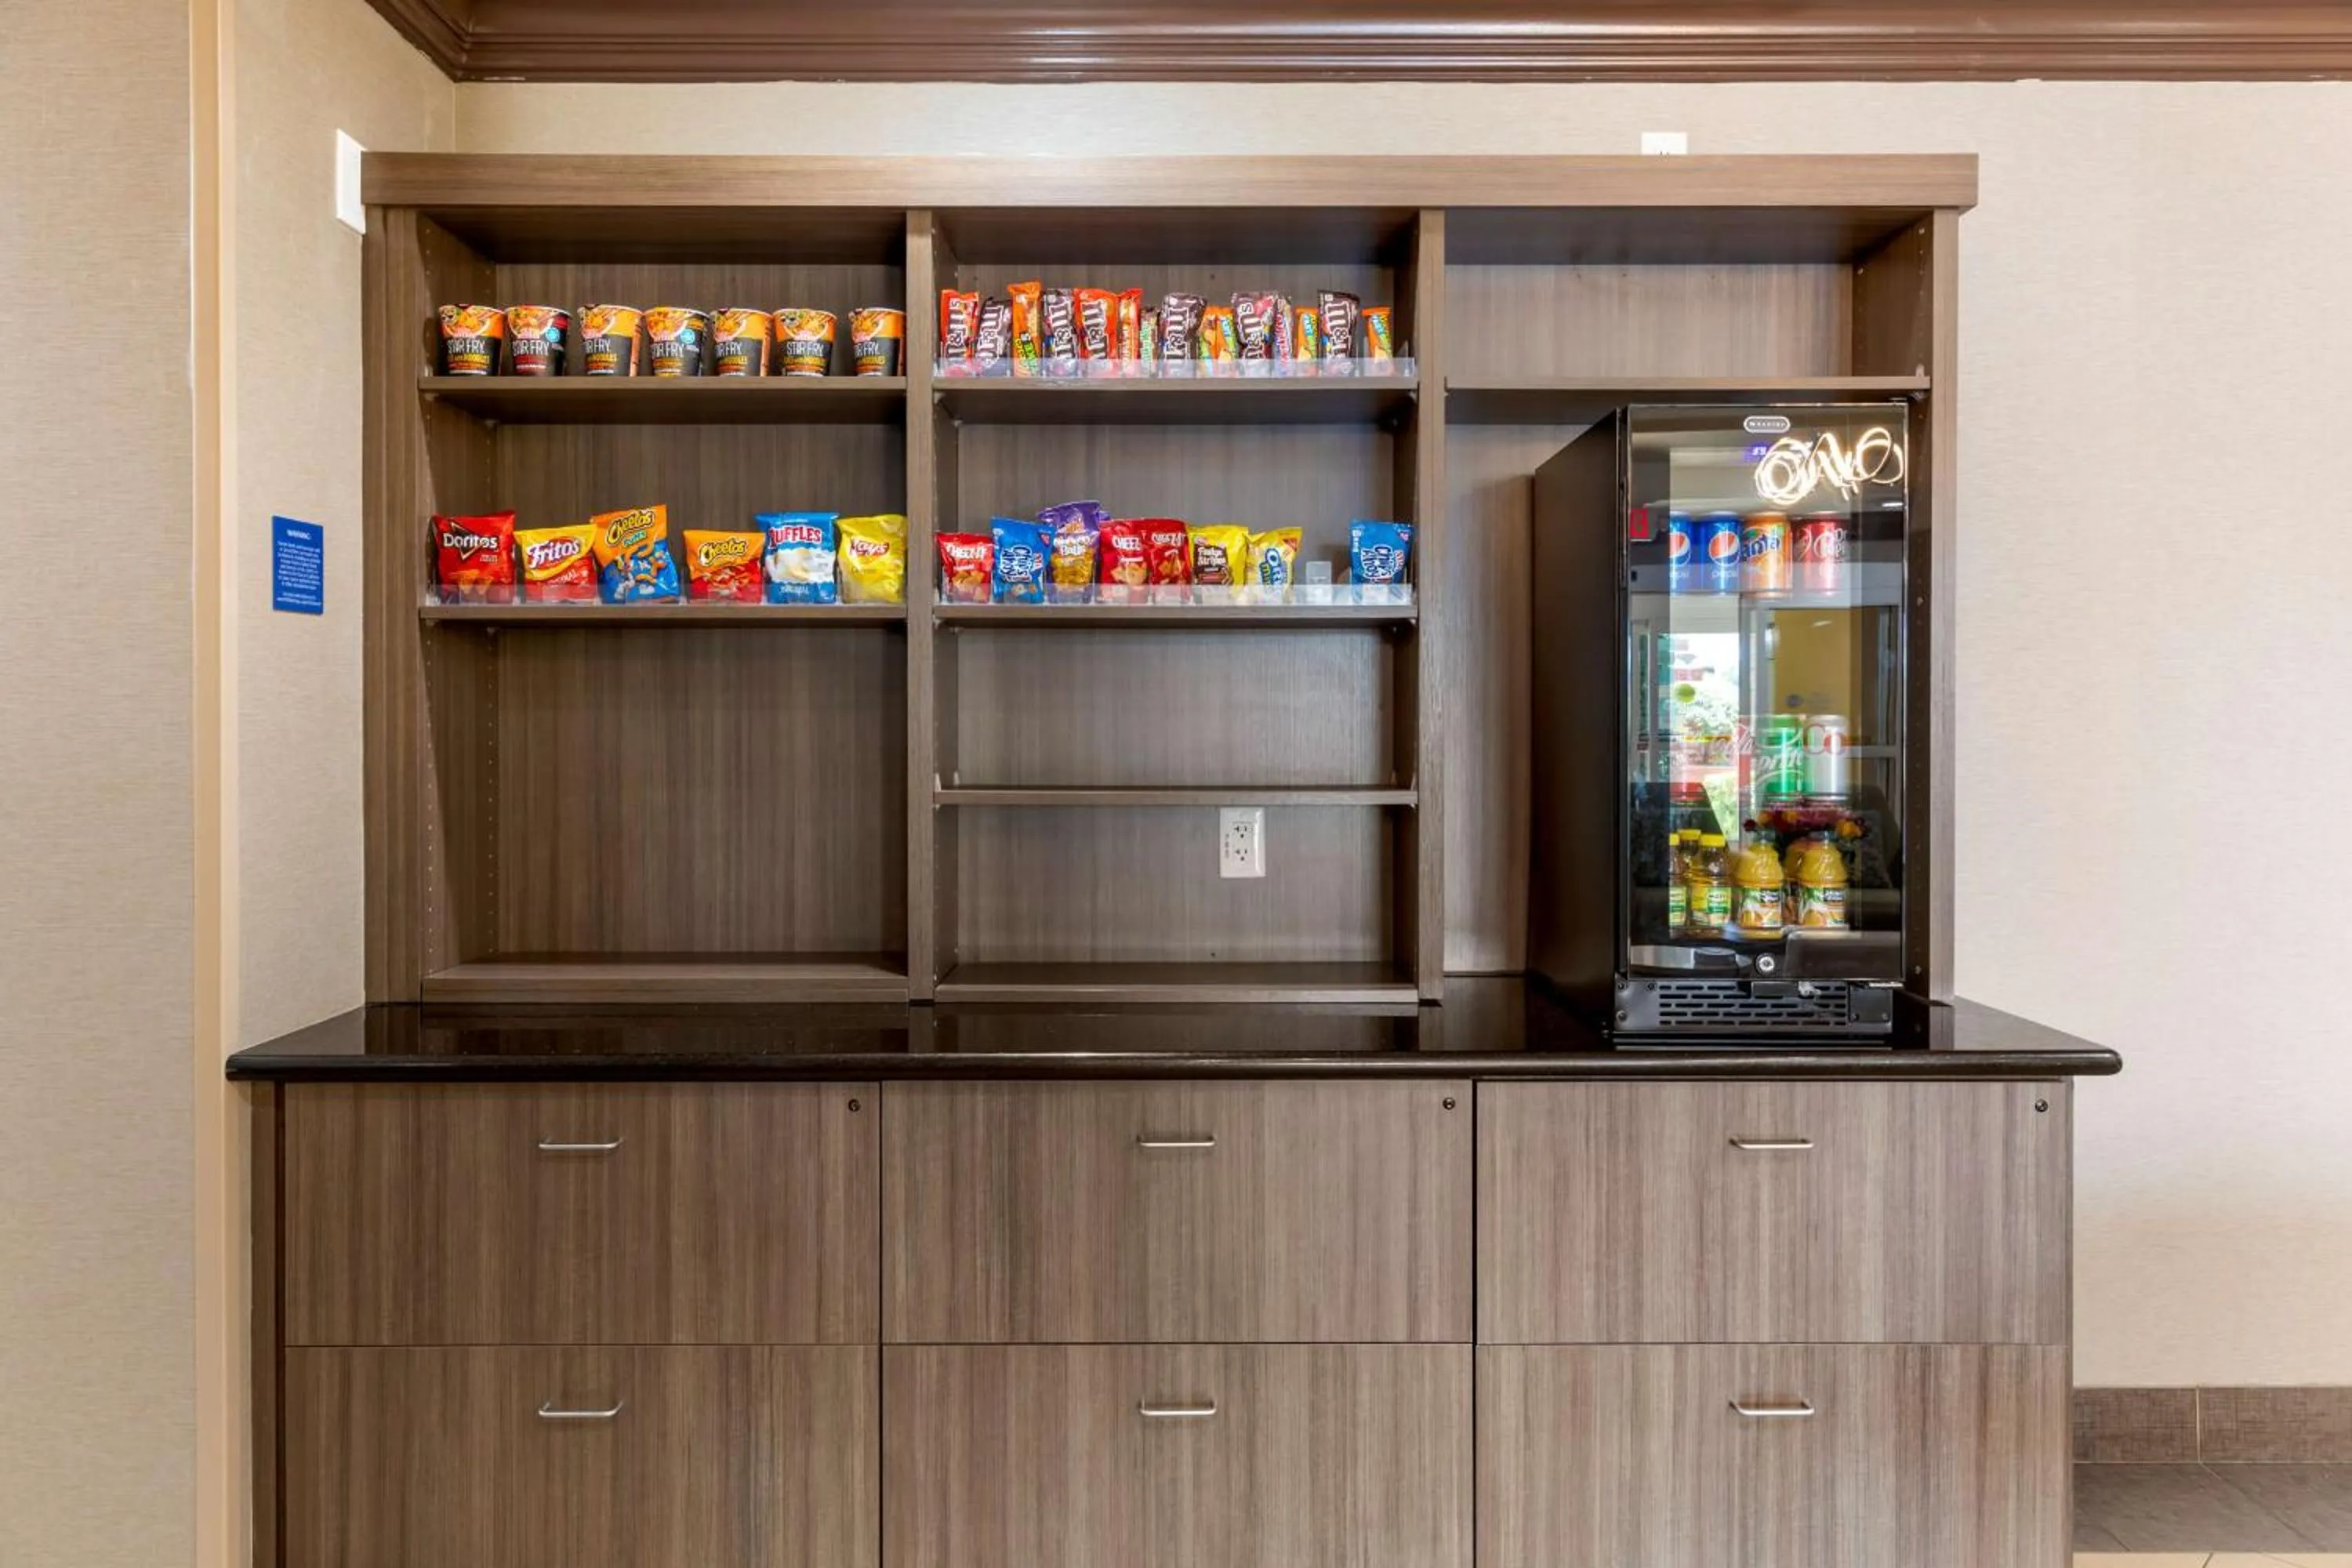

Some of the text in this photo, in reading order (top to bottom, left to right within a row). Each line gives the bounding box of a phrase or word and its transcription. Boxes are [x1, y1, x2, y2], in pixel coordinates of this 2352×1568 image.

[466, 338, 485, 354] FRY
[530, 339, 550, 355] FRY
[606, 510, 655, 544] Cheetos
[443, 532, 498, 548] Doritos
[527, 539, 580, 568] Fritos
[699, 538, 746, 565] Cheetos
